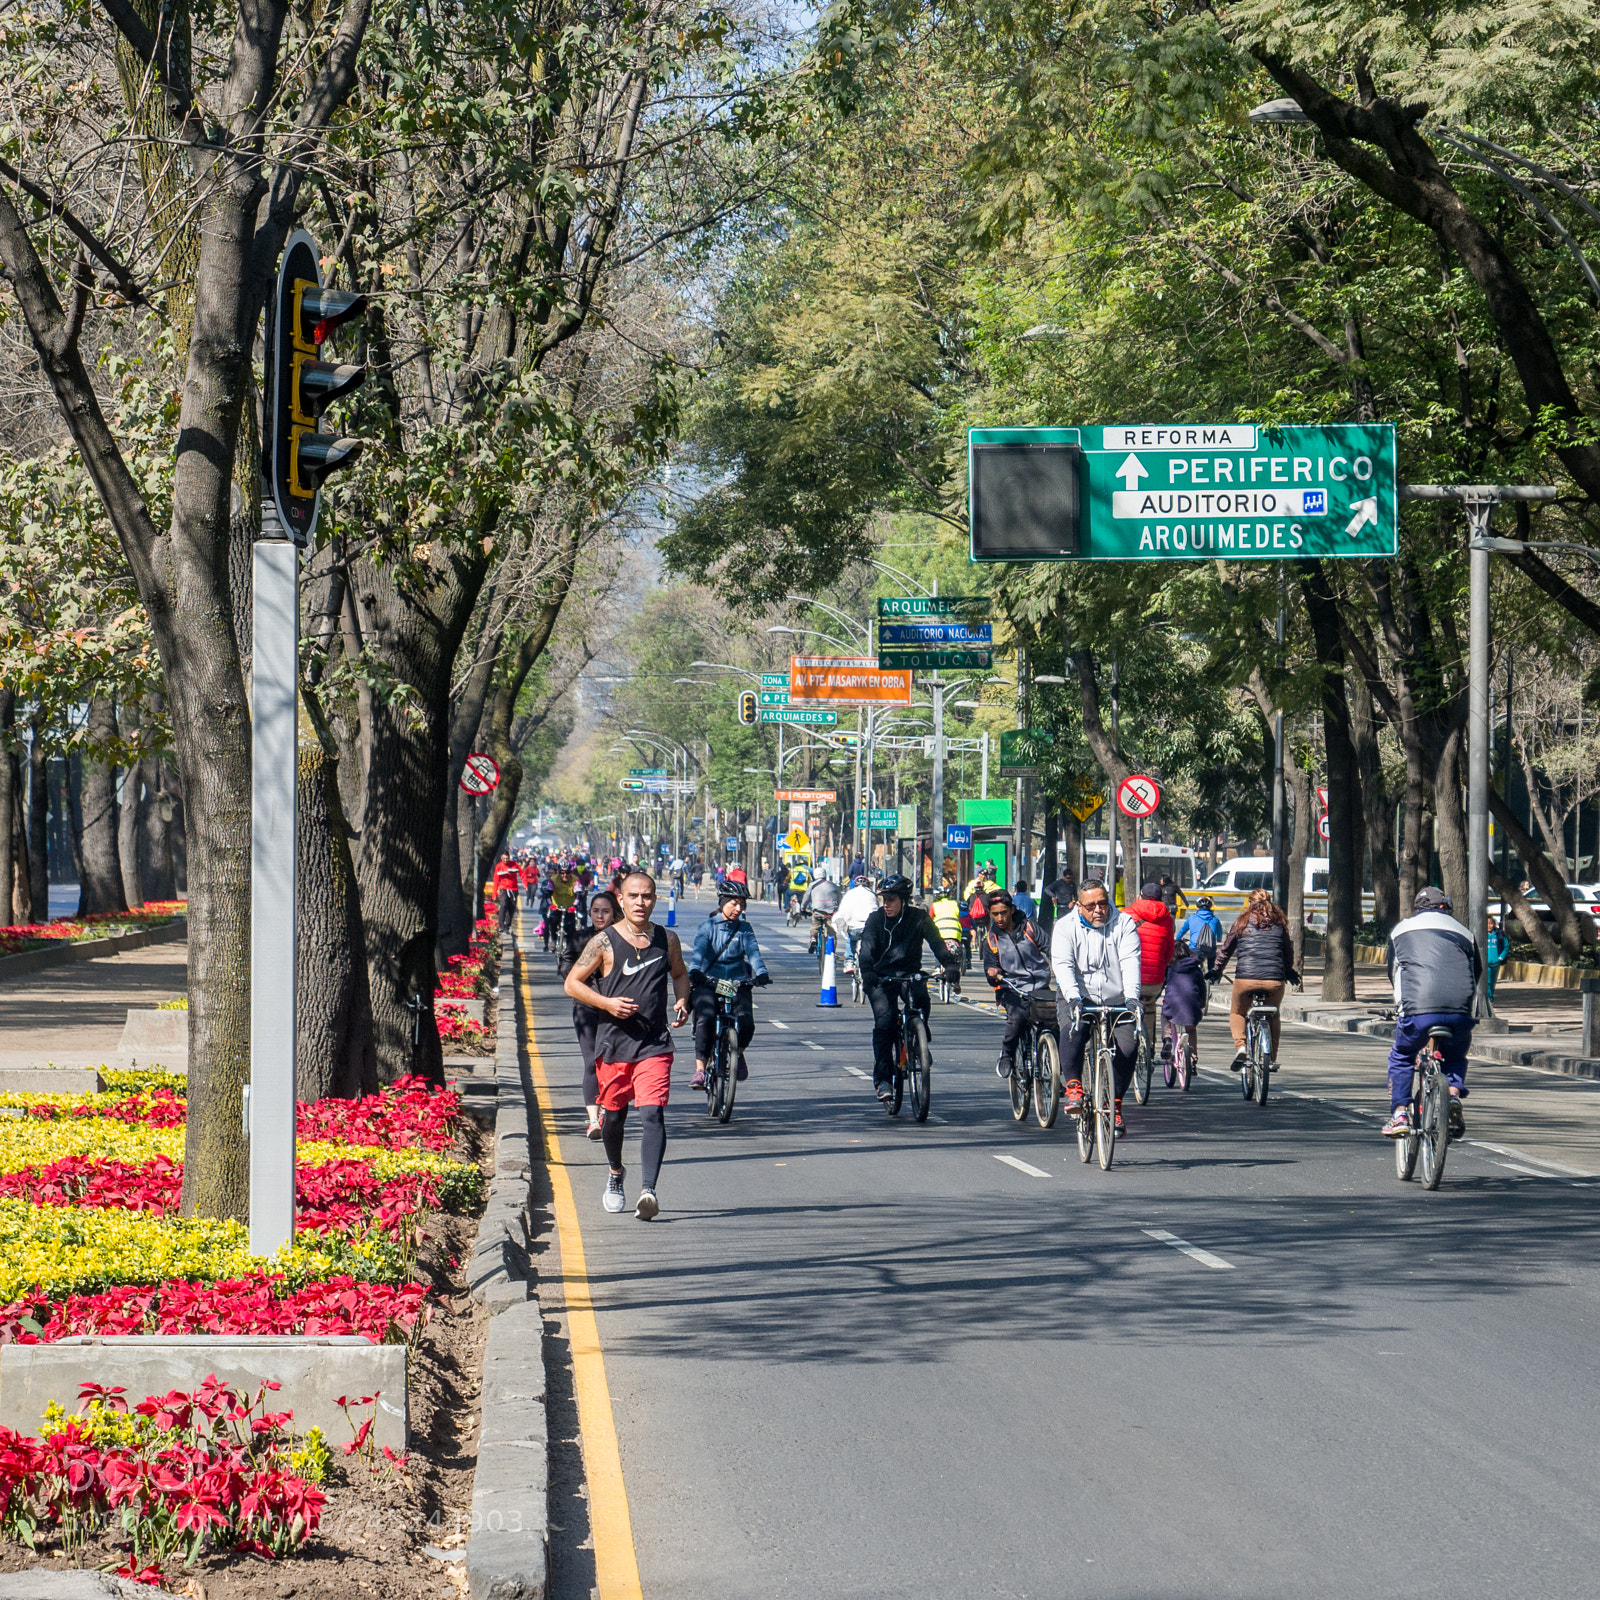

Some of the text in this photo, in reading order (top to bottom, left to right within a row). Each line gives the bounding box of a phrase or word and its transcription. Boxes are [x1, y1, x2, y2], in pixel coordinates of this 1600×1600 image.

[1124, 430, 1232, 445] REFORMA
[1168, 456, 1373, 484] PERIFERICO
[1139, 494, 1277, 514] AUDITORIO
[1138, 523, 1304, 551] ARQUIMEDES
[882, 601, 962, 613] ARQUIMED
[900, 627, 989, 639] AUDITORIO NACIONAL
[901, 655, 973, 666] TOLUCA
[763, 676, 782, 684] ZONA
[795, 674, 807, 687] AV.
[809, 675, 827, 687] PTE.
[828, 675, 868, 688] MASARYK
[869, 676, 880, 688] EN
[881, 676, 905, 689] OBRA
[762, 712, 823, 722] ARQUIMEDES
[793, 792, 834, 800] AUDITORIO
